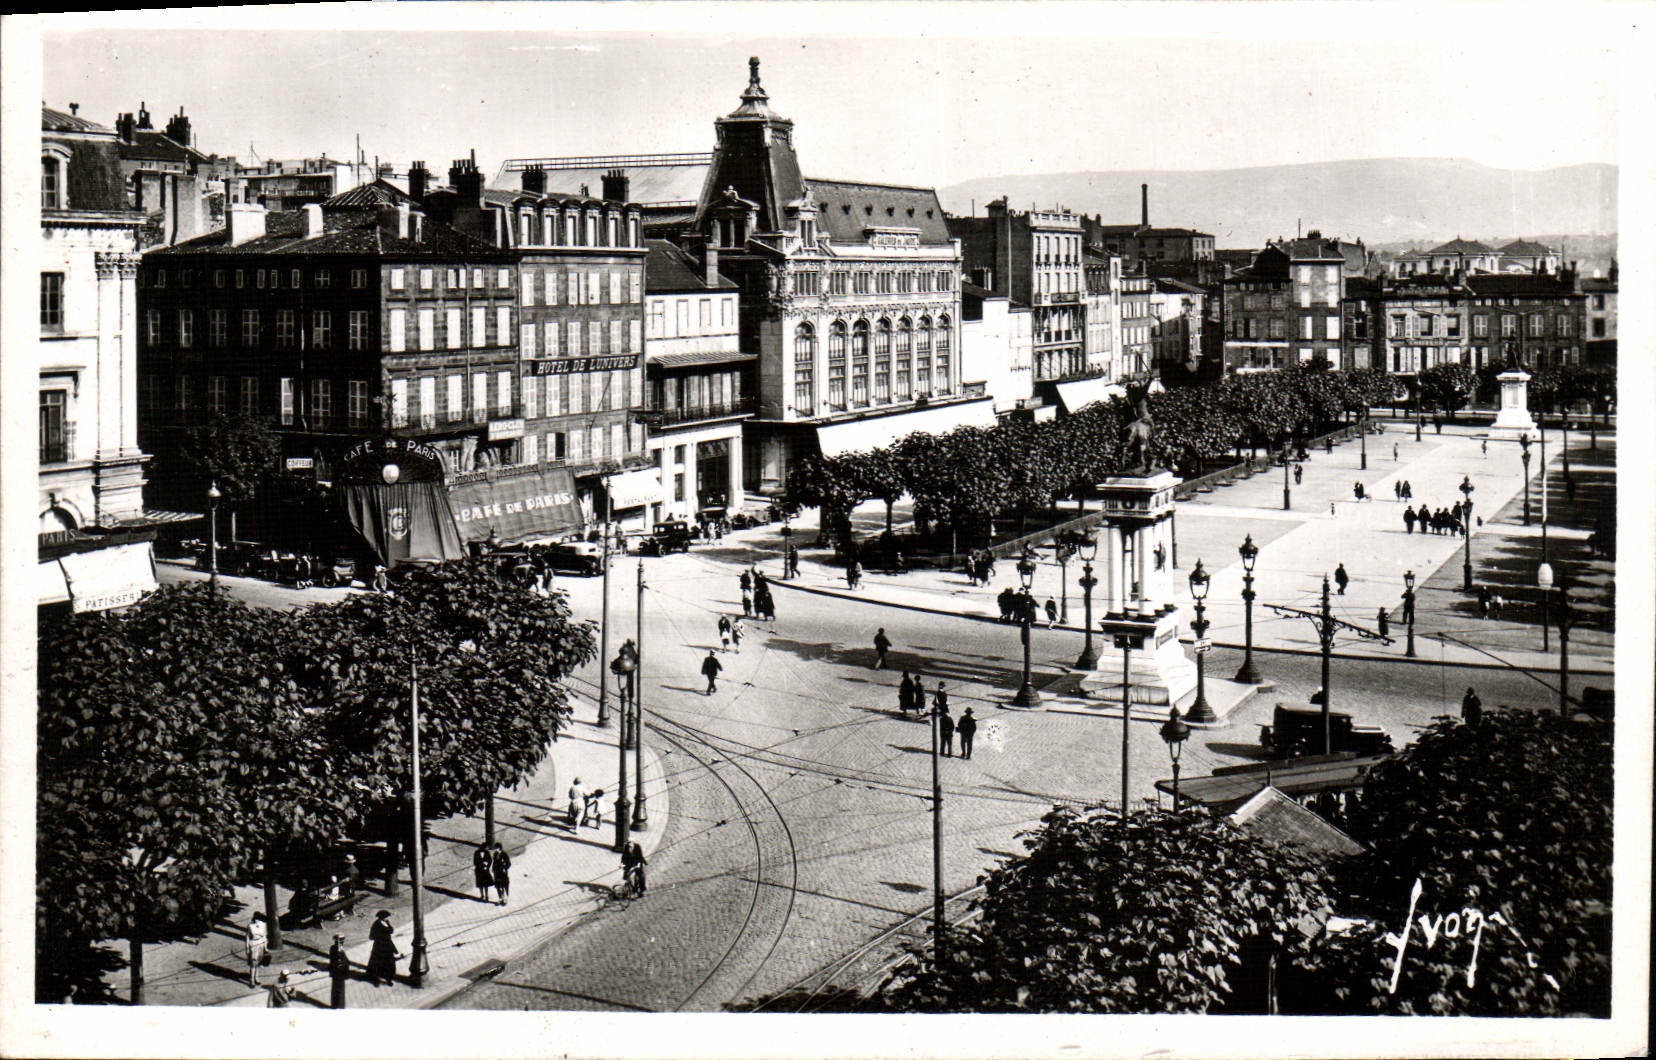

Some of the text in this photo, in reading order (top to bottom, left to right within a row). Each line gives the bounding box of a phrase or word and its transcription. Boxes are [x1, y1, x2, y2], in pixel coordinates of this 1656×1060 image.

[572, 359, 587, 371] DE
[406, 440, 434, 460] PARIS
[505, 502, 523, 514] DE
